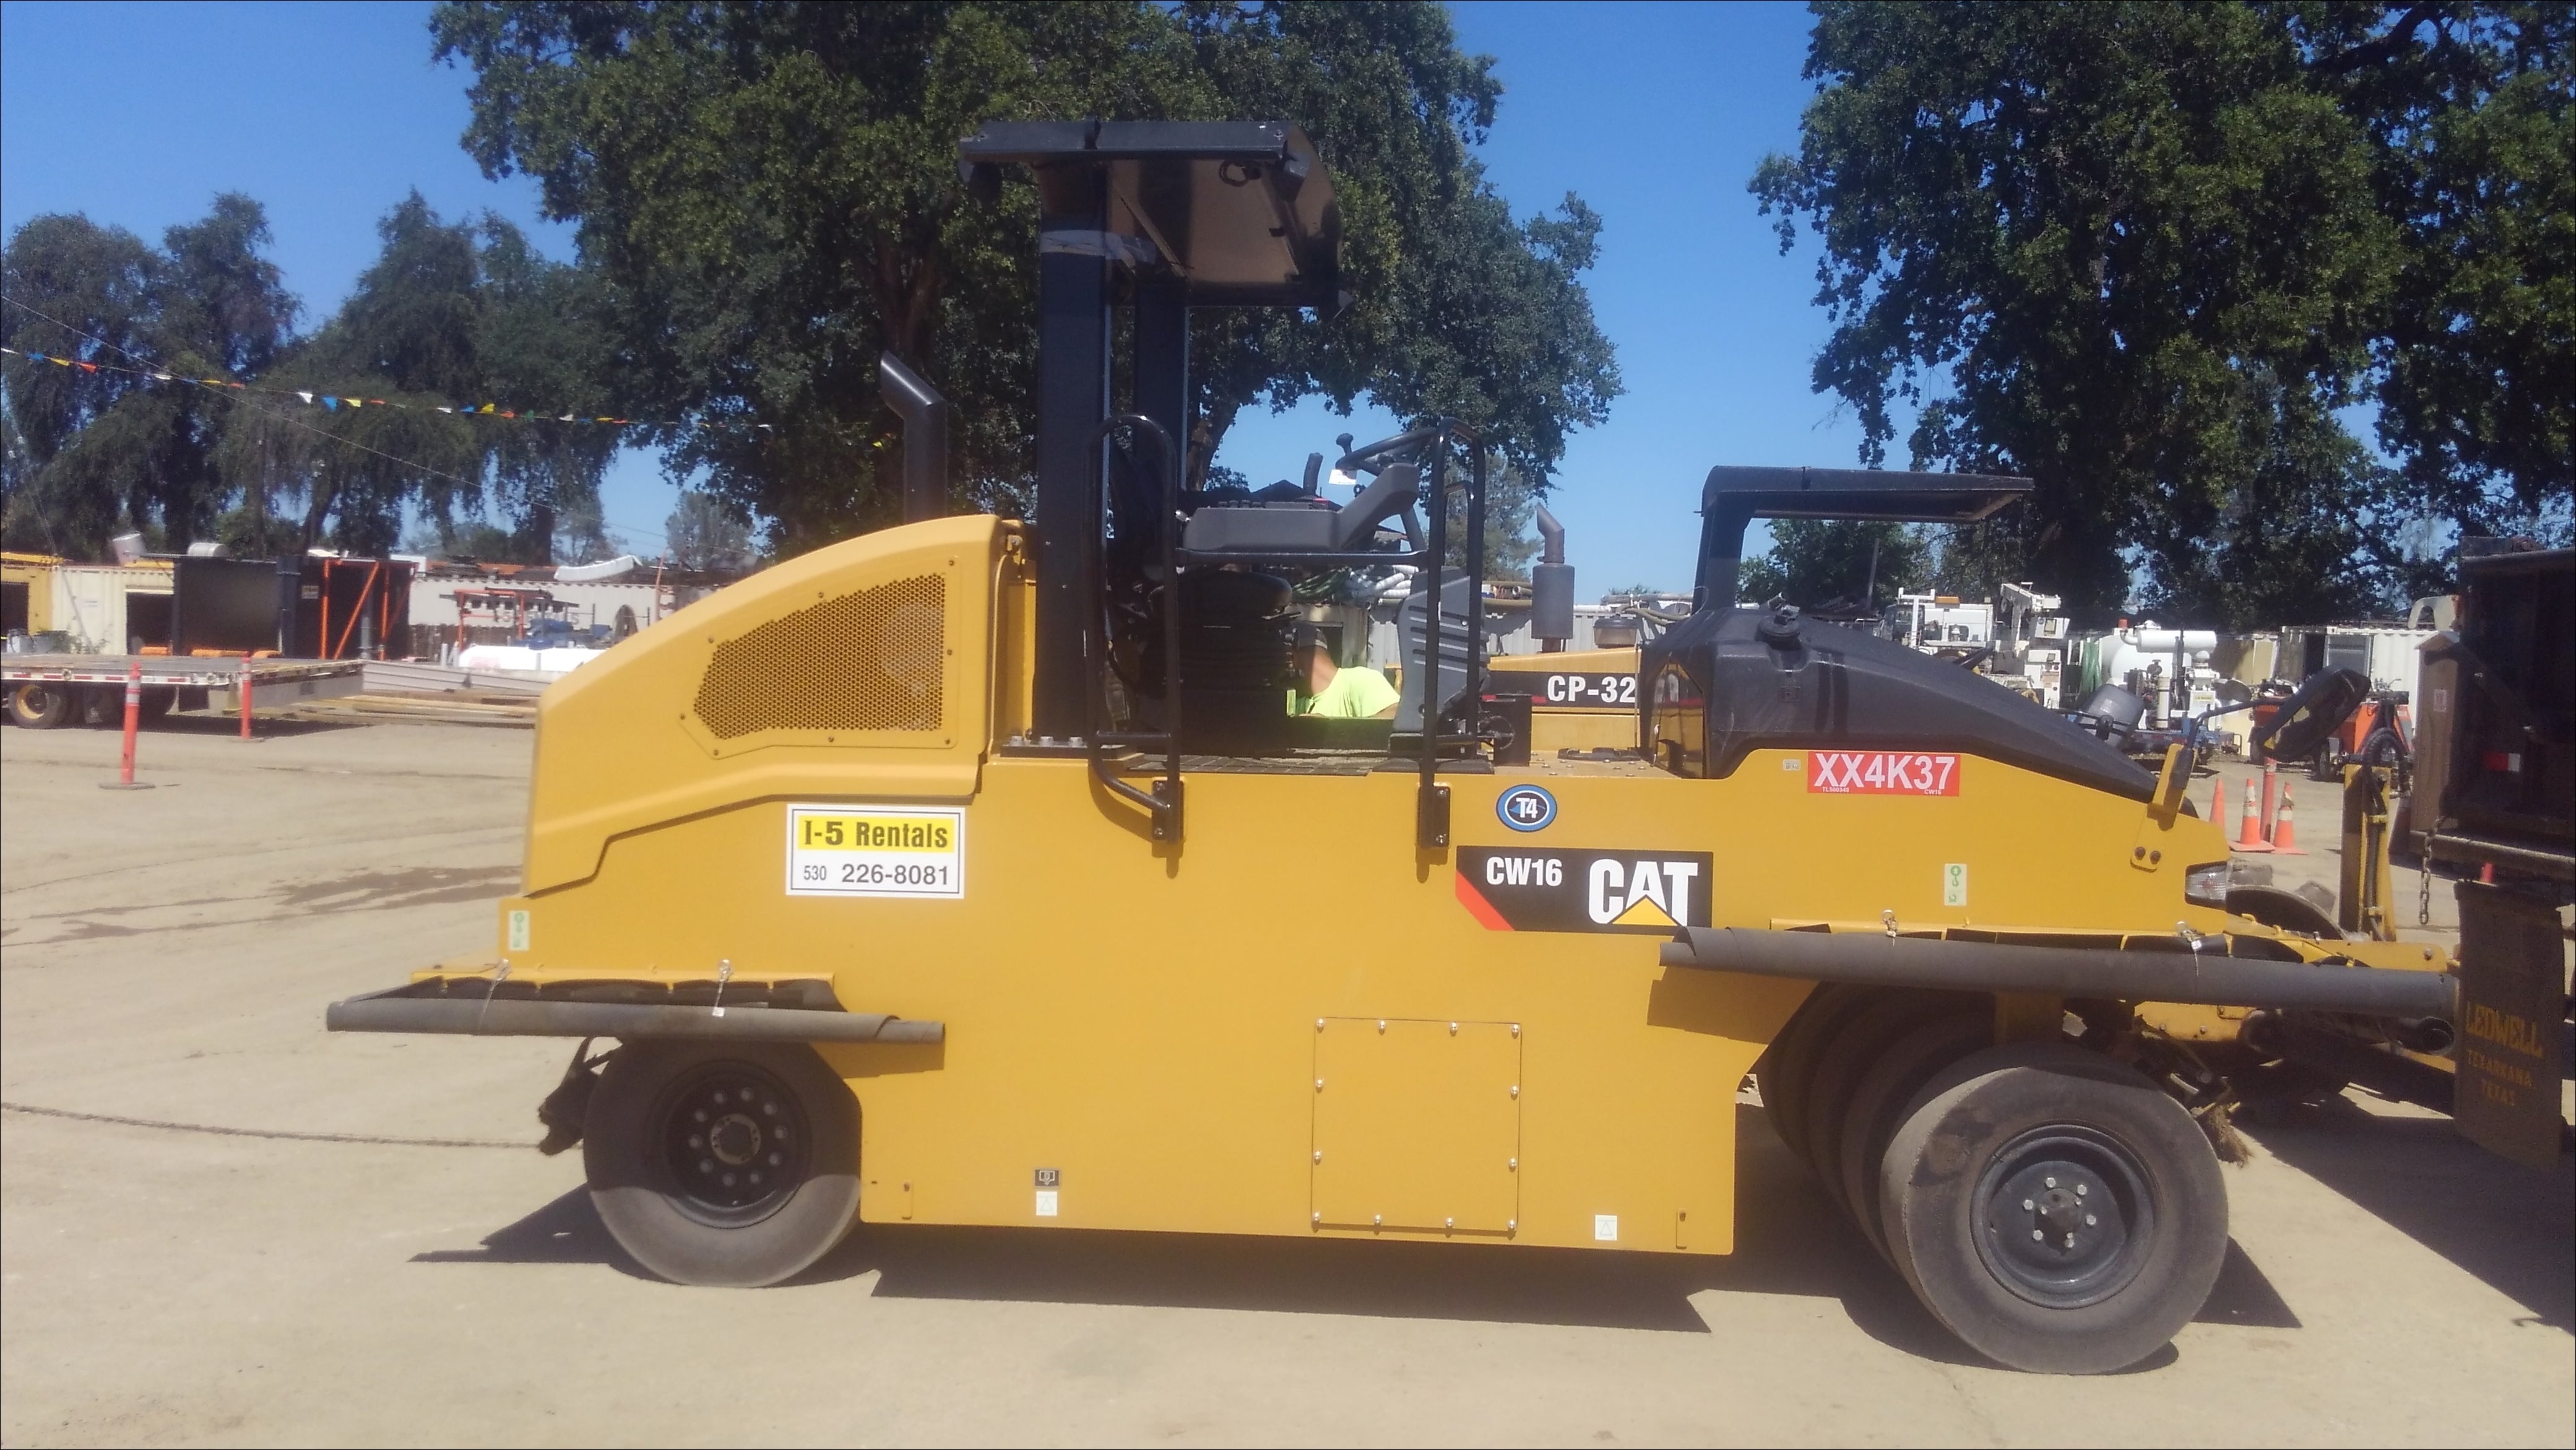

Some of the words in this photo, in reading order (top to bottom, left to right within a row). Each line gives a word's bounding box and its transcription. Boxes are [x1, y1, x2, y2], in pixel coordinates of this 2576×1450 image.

[1813, 753, 1955, 790] XX4K37
[1516, 797, 1538, 818] T4
[804, 820, 844, 846] I-5
[855, 822, 948, 848] Rentals
[803, 865, 827, 881] 530
[842, 863, 948, 885] 226-8081
[1486, 857, 1563, 887] CW16
[1589, 859, 1698, 926] CAT
[2465, 1001, 2543, 1059] LEDWELL
[2481, 1079, 2515, 1106] TEXAS
